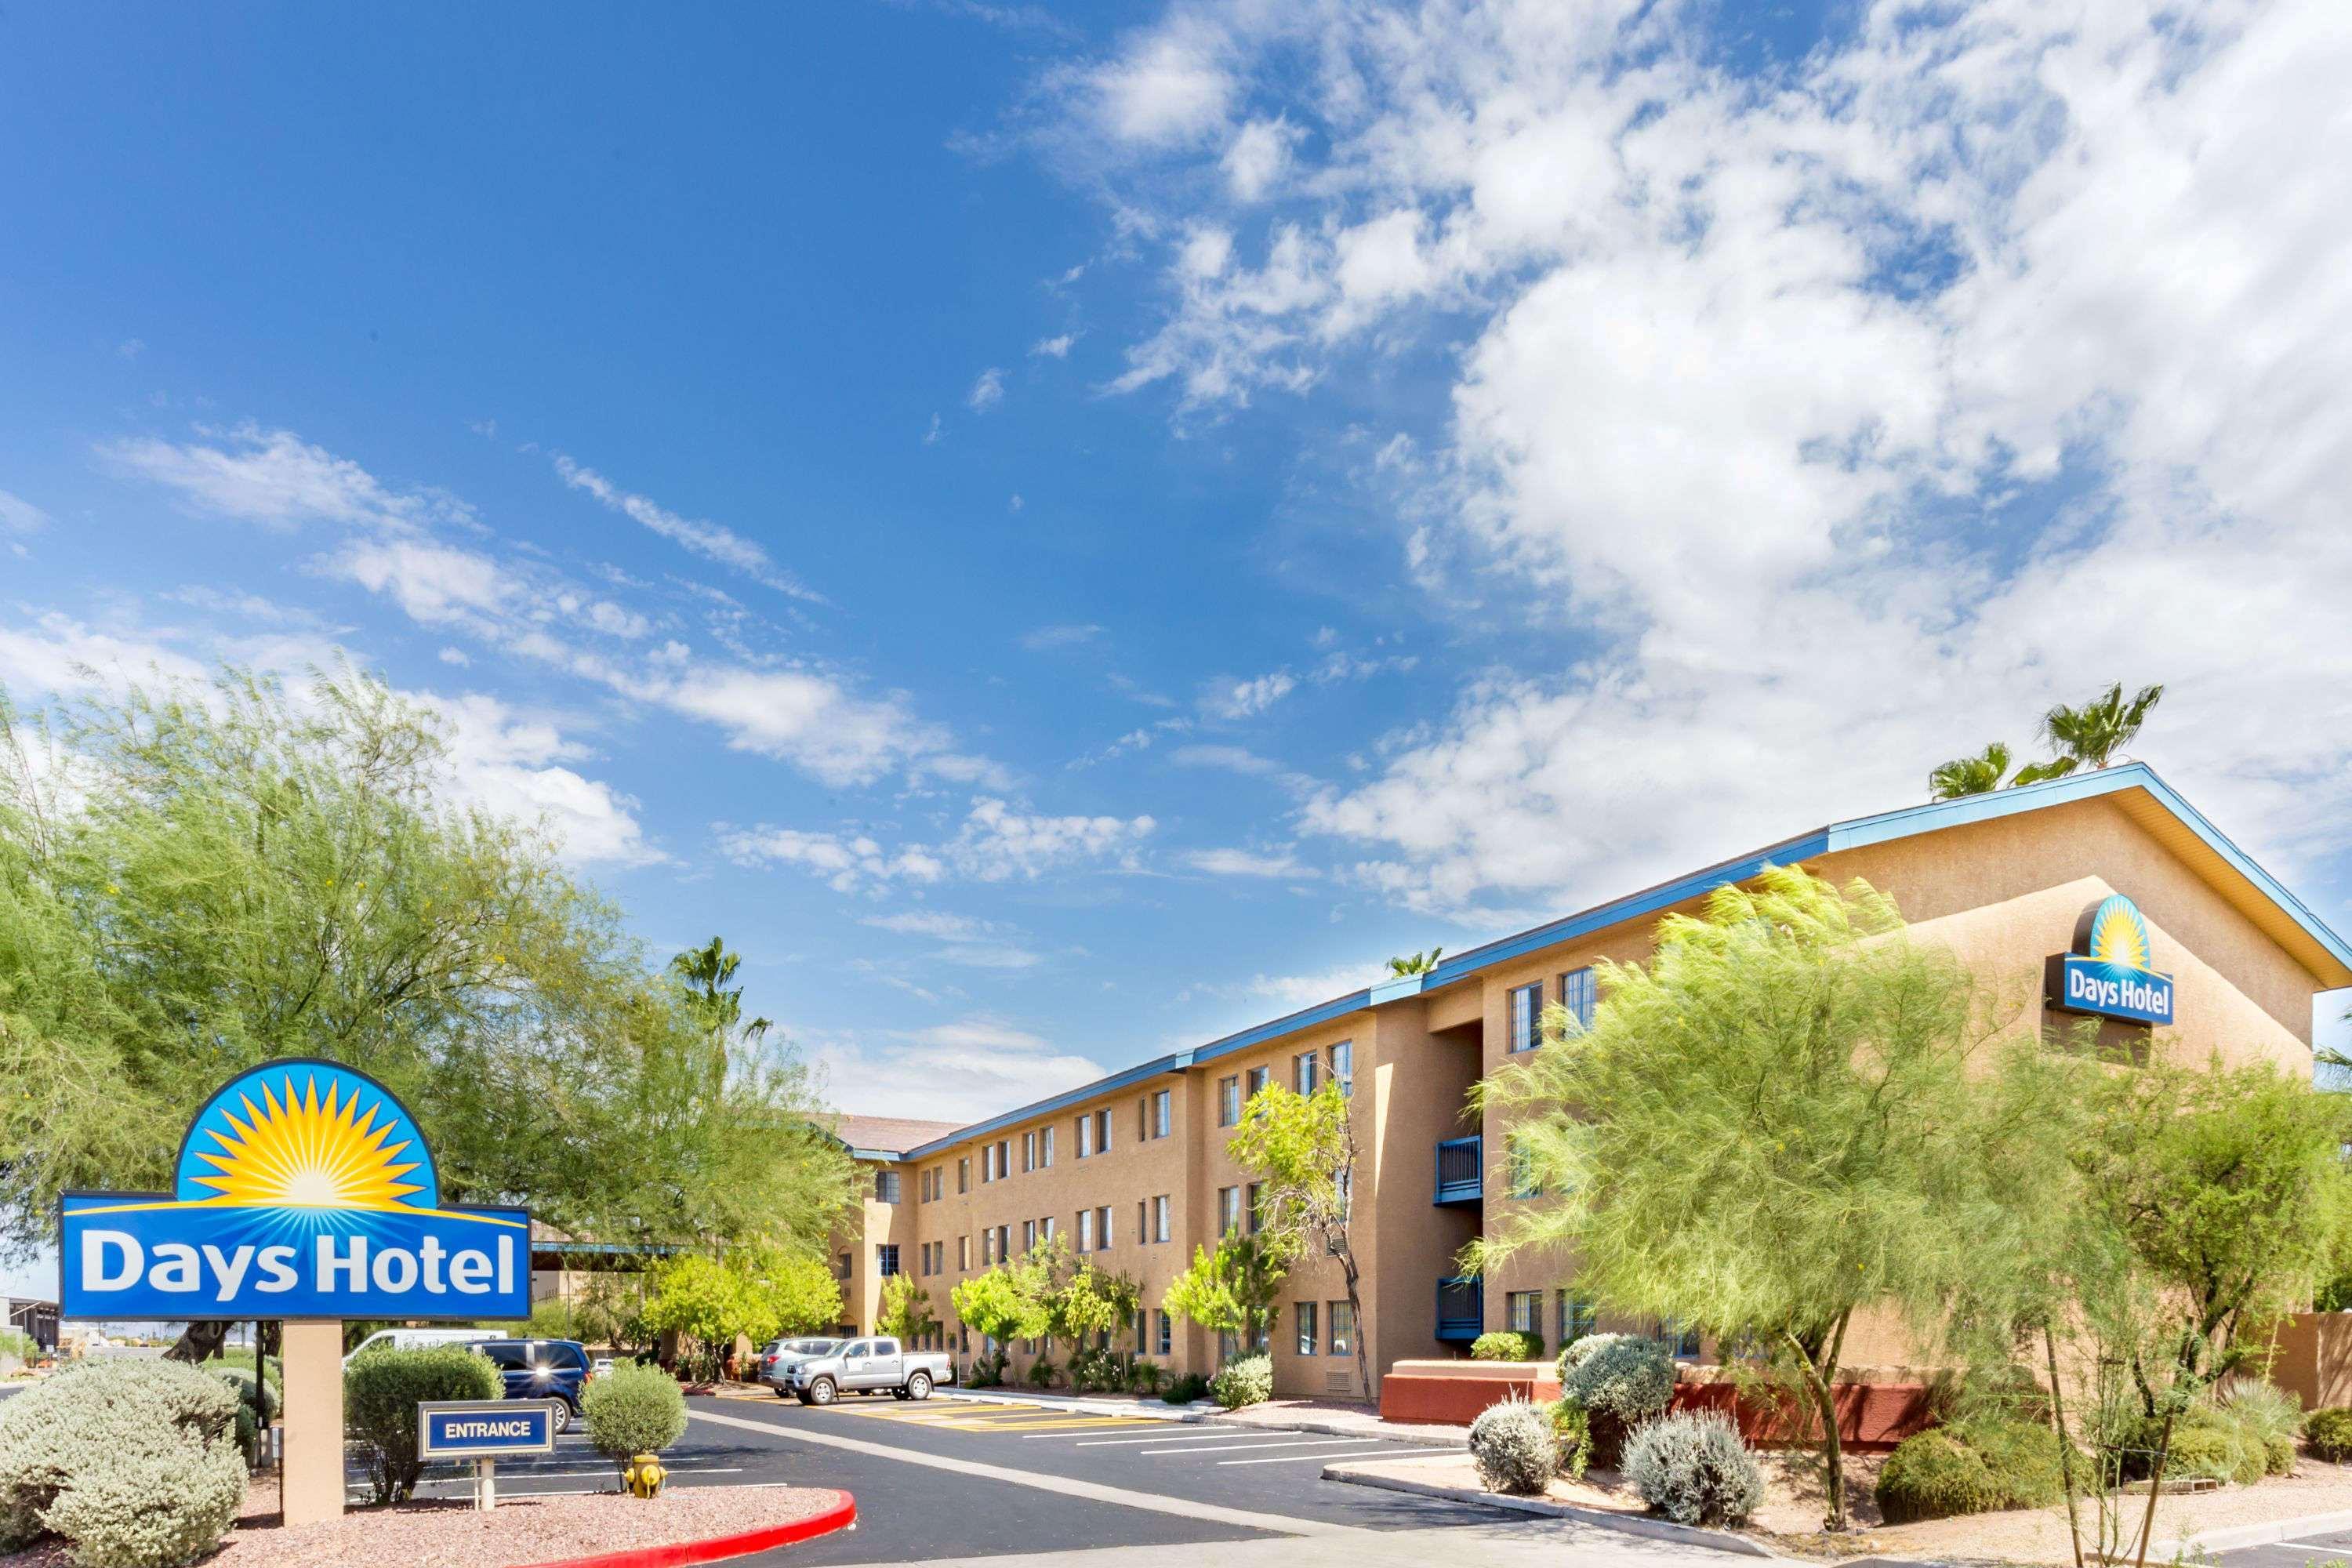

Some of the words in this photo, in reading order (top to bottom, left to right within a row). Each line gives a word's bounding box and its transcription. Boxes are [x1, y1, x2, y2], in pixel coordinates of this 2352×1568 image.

[2071, 968, 2118, 1007] Days
[2121, 979, 2169, 1014] Hotel
[82, 1229, 298, 1301] Days
[316, 1234, 514, 1294] Hotel
[445, 1421, 531, 1439] ENTRANCE
